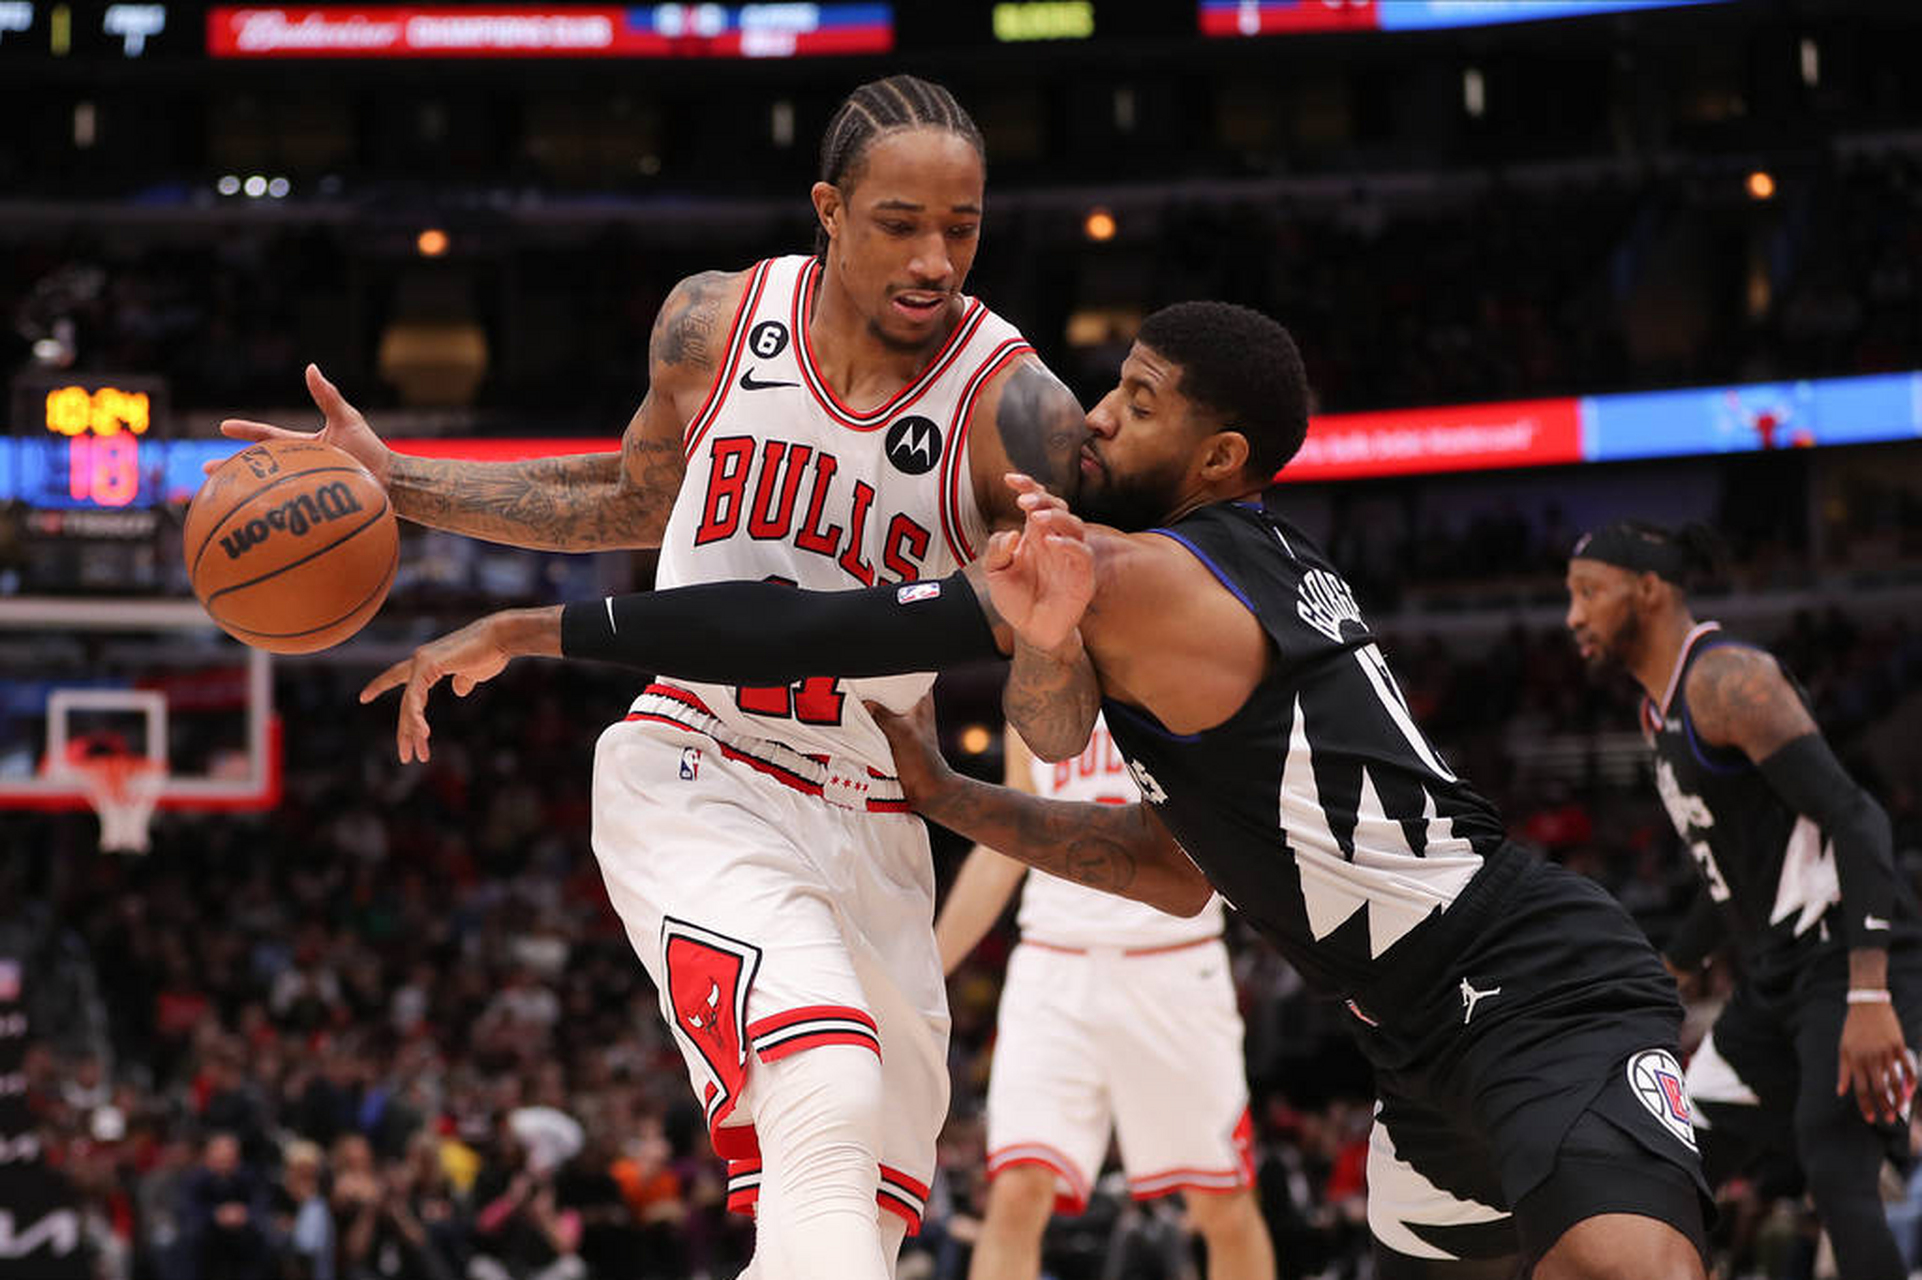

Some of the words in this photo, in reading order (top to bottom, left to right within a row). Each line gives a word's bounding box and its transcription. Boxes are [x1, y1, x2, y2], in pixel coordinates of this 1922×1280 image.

[756, 326, 782, 355] 6
[69, 431, 138, 506] 18
[219, 481, 363, 559] Wilson
[694, 435, 931, 587] BULLS
